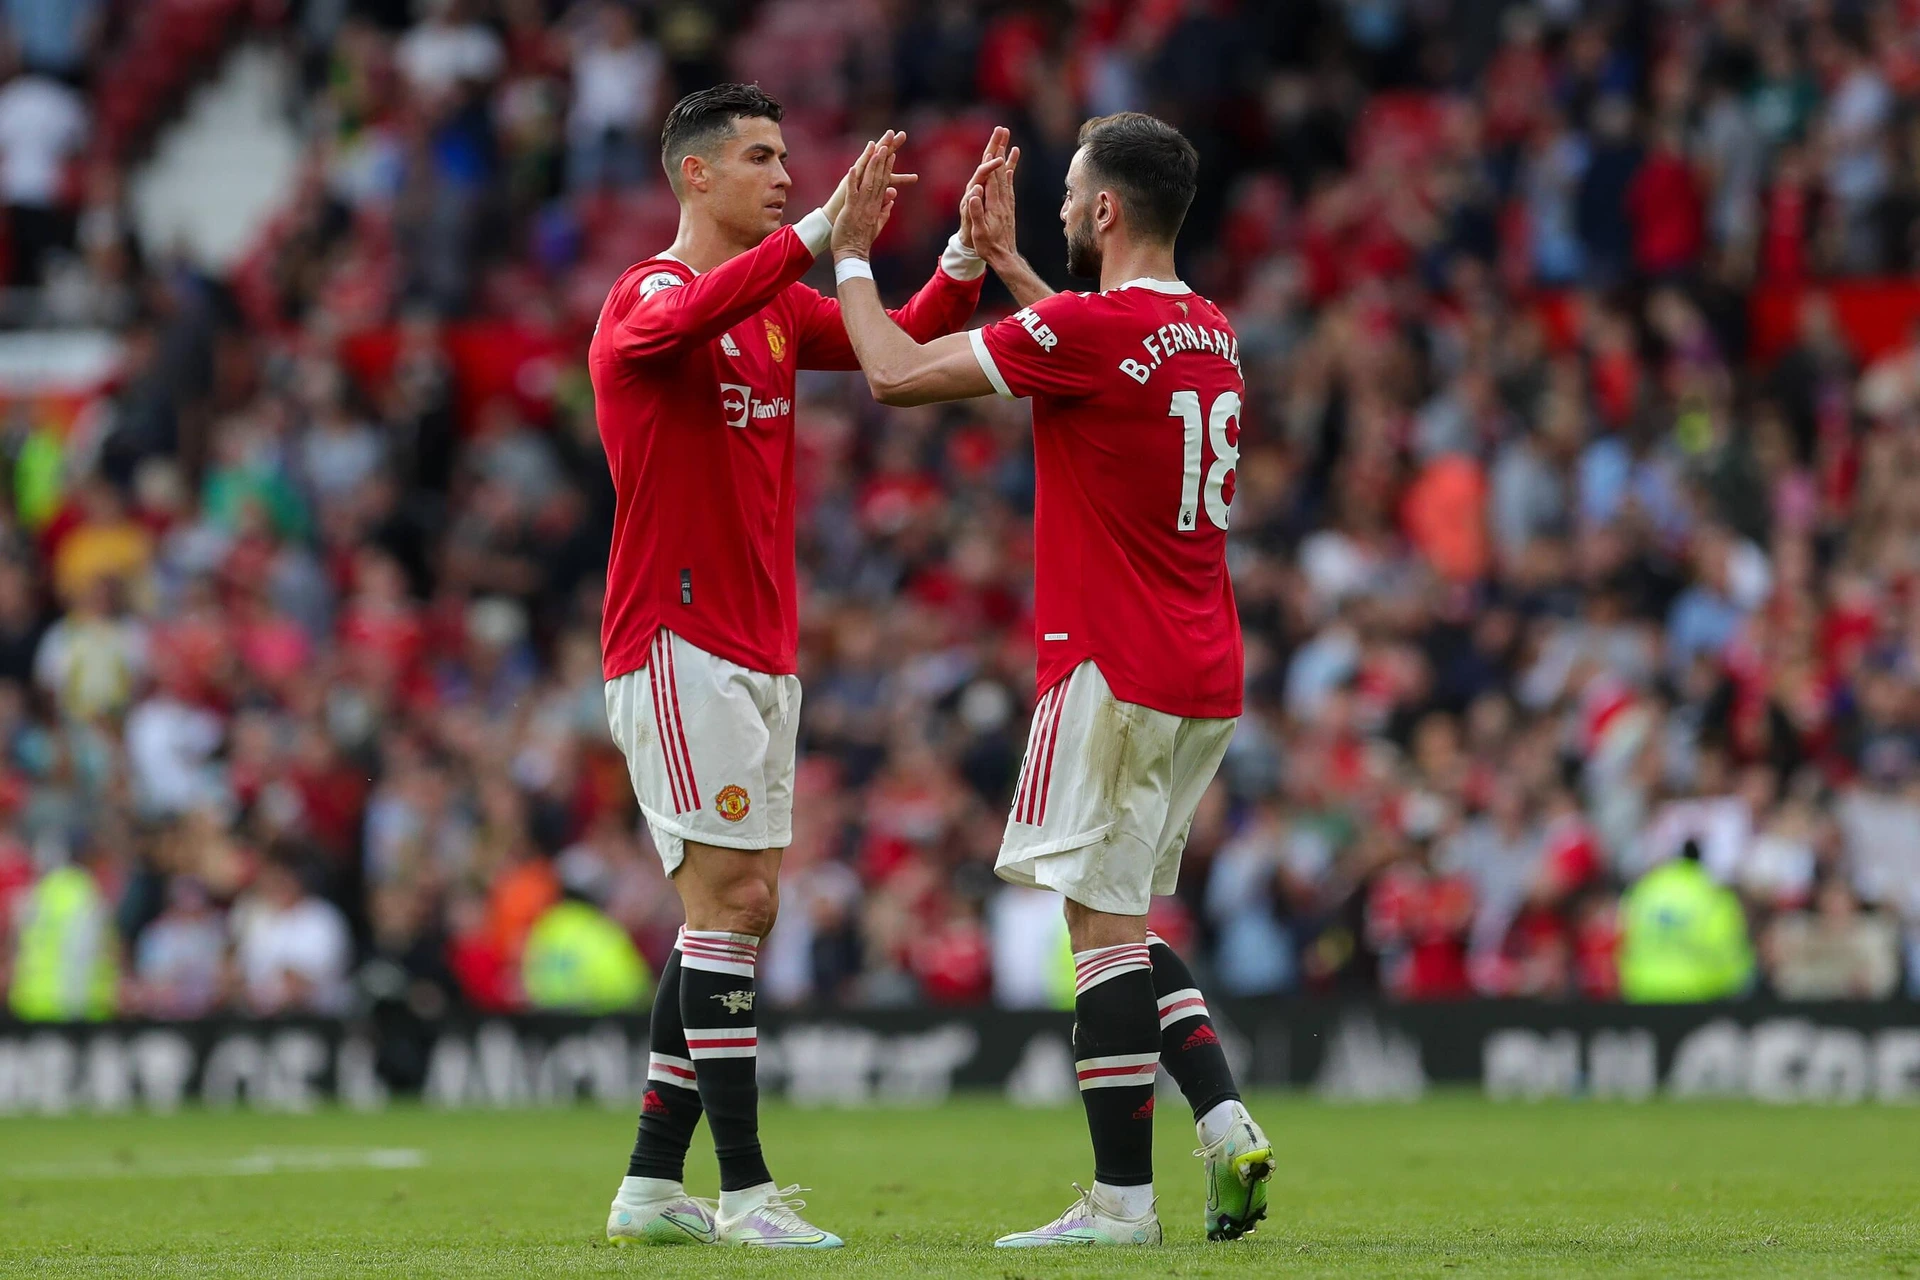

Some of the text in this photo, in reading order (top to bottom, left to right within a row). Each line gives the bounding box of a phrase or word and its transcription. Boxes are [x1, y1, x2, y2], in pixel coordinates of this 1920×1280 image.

[1012, 306, 1058, 353] HLER
[1118, 322, 1244, 387] B.FERNAND
[1168, 390, 1242, 531] 18
